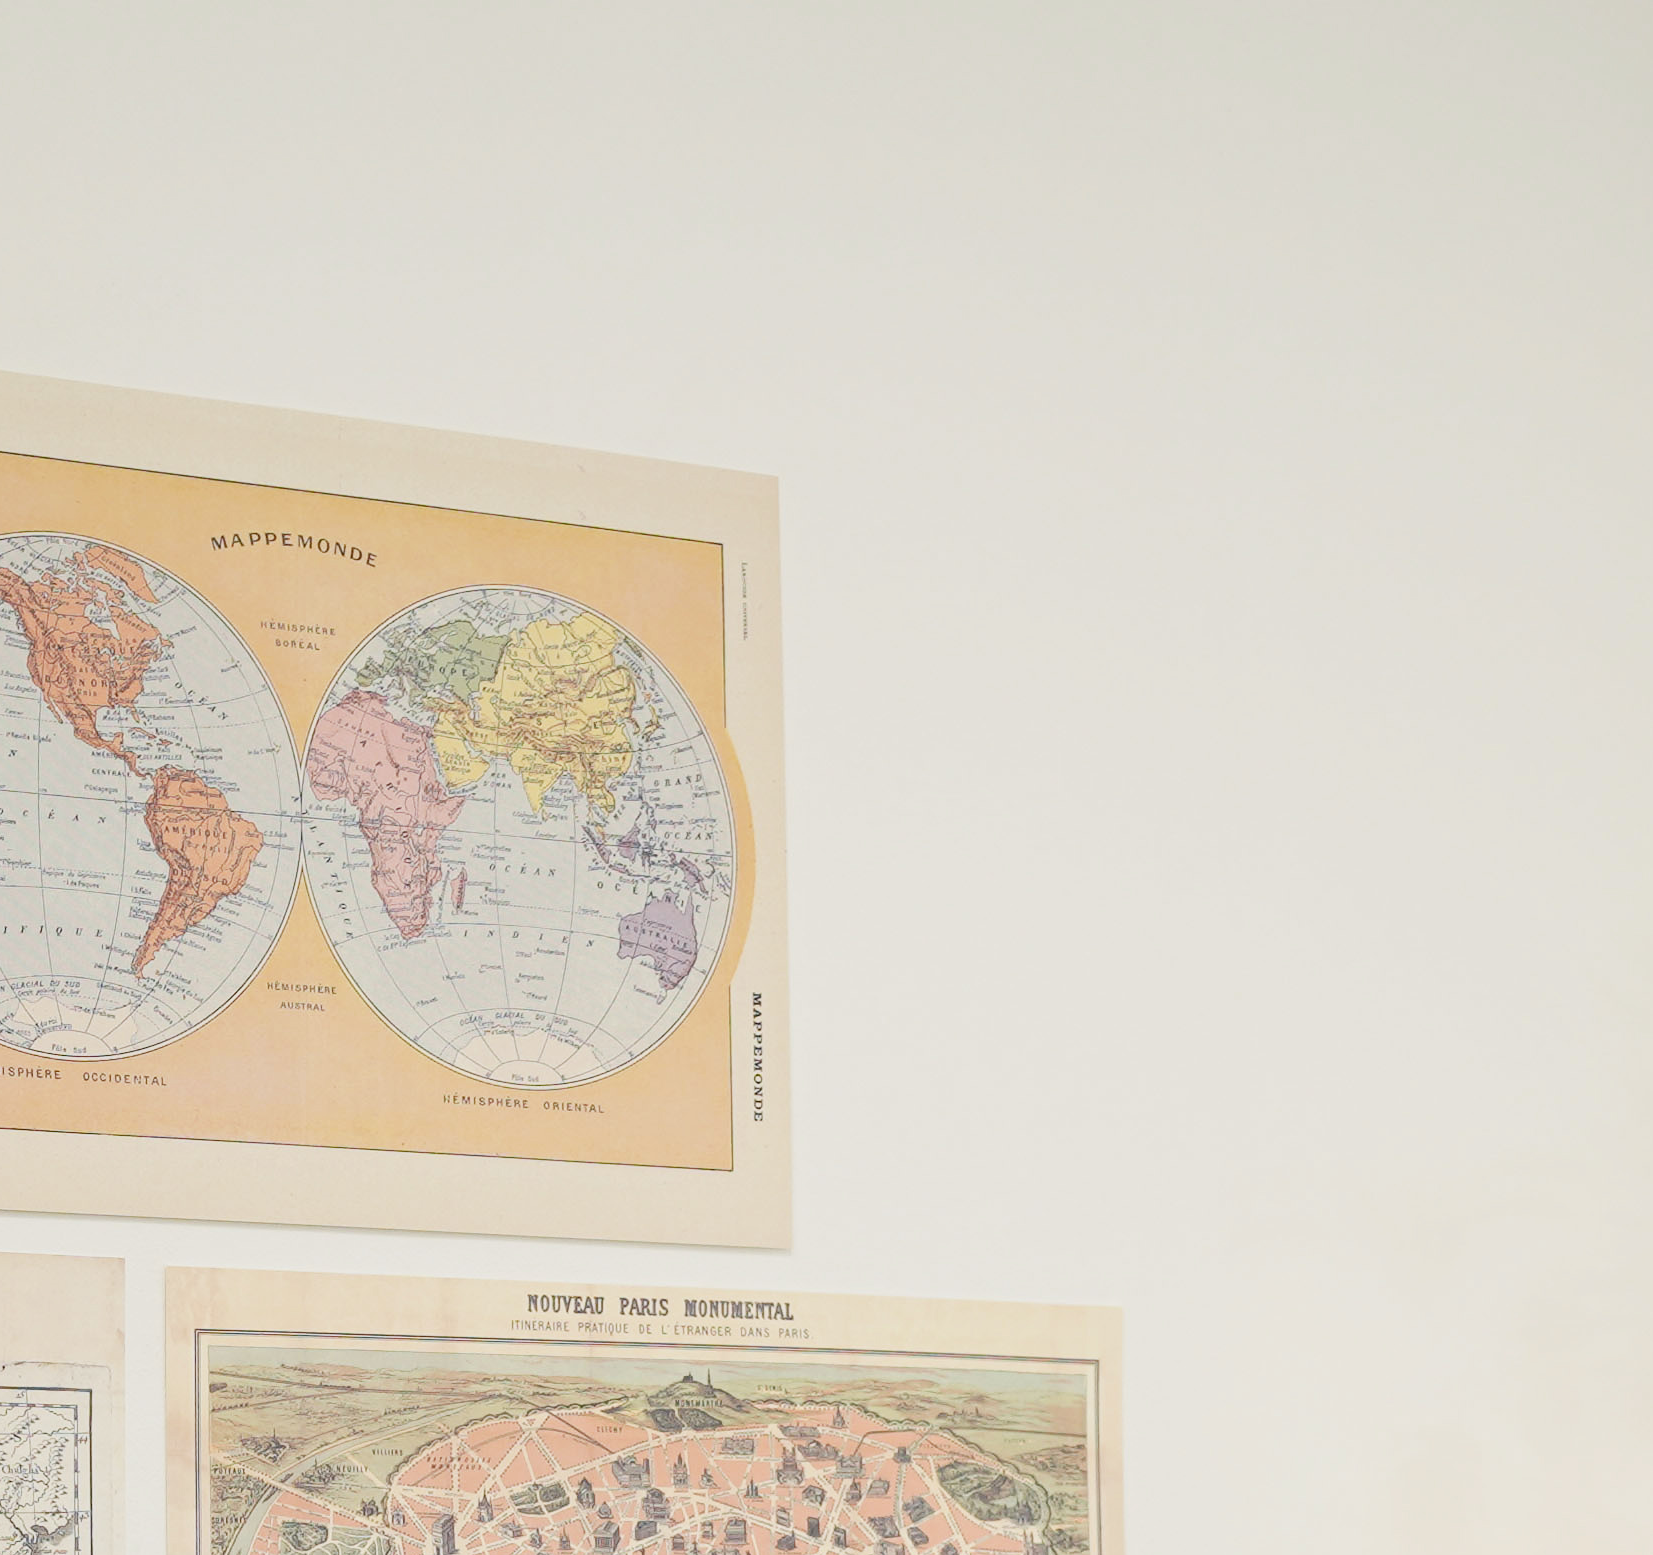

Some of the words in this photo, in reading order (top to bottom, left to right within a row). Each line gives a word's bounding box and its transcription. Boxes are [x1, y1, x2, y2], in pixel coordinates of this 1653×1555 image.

[211, 532, 377, 567] MAPPEMONDE
[260, 618, 336, 636] HÉMISPHÈRE
[275, 638, 320, 650] BORÉAL
[408, 655, 468, 677] EUROPE
[267, 981, 337, 995] HÉMISPHÈRE
[280, 1001, 325, 1011] AUSTRAL
[753, 992, 764, 1122] MAPPEMONDE
[83, 1072, 167, 1086] OCCIDENTAL
[443, 1093, 529, 1109] HÉMISPHÈRE
[543, 1101, 605, 1114] ORIENTAL
[527, 1294, 605, 1315] NOUVEAU
[619, 1297, 669, 1317] PARIS
[684, 1299, 794, 1321] MONUMENTAL
[578, 1321, 629, 1335] PRATIQUE
[638, 1324, 652, 1335] DE
[740, 1327, 770, 1338] DANS
